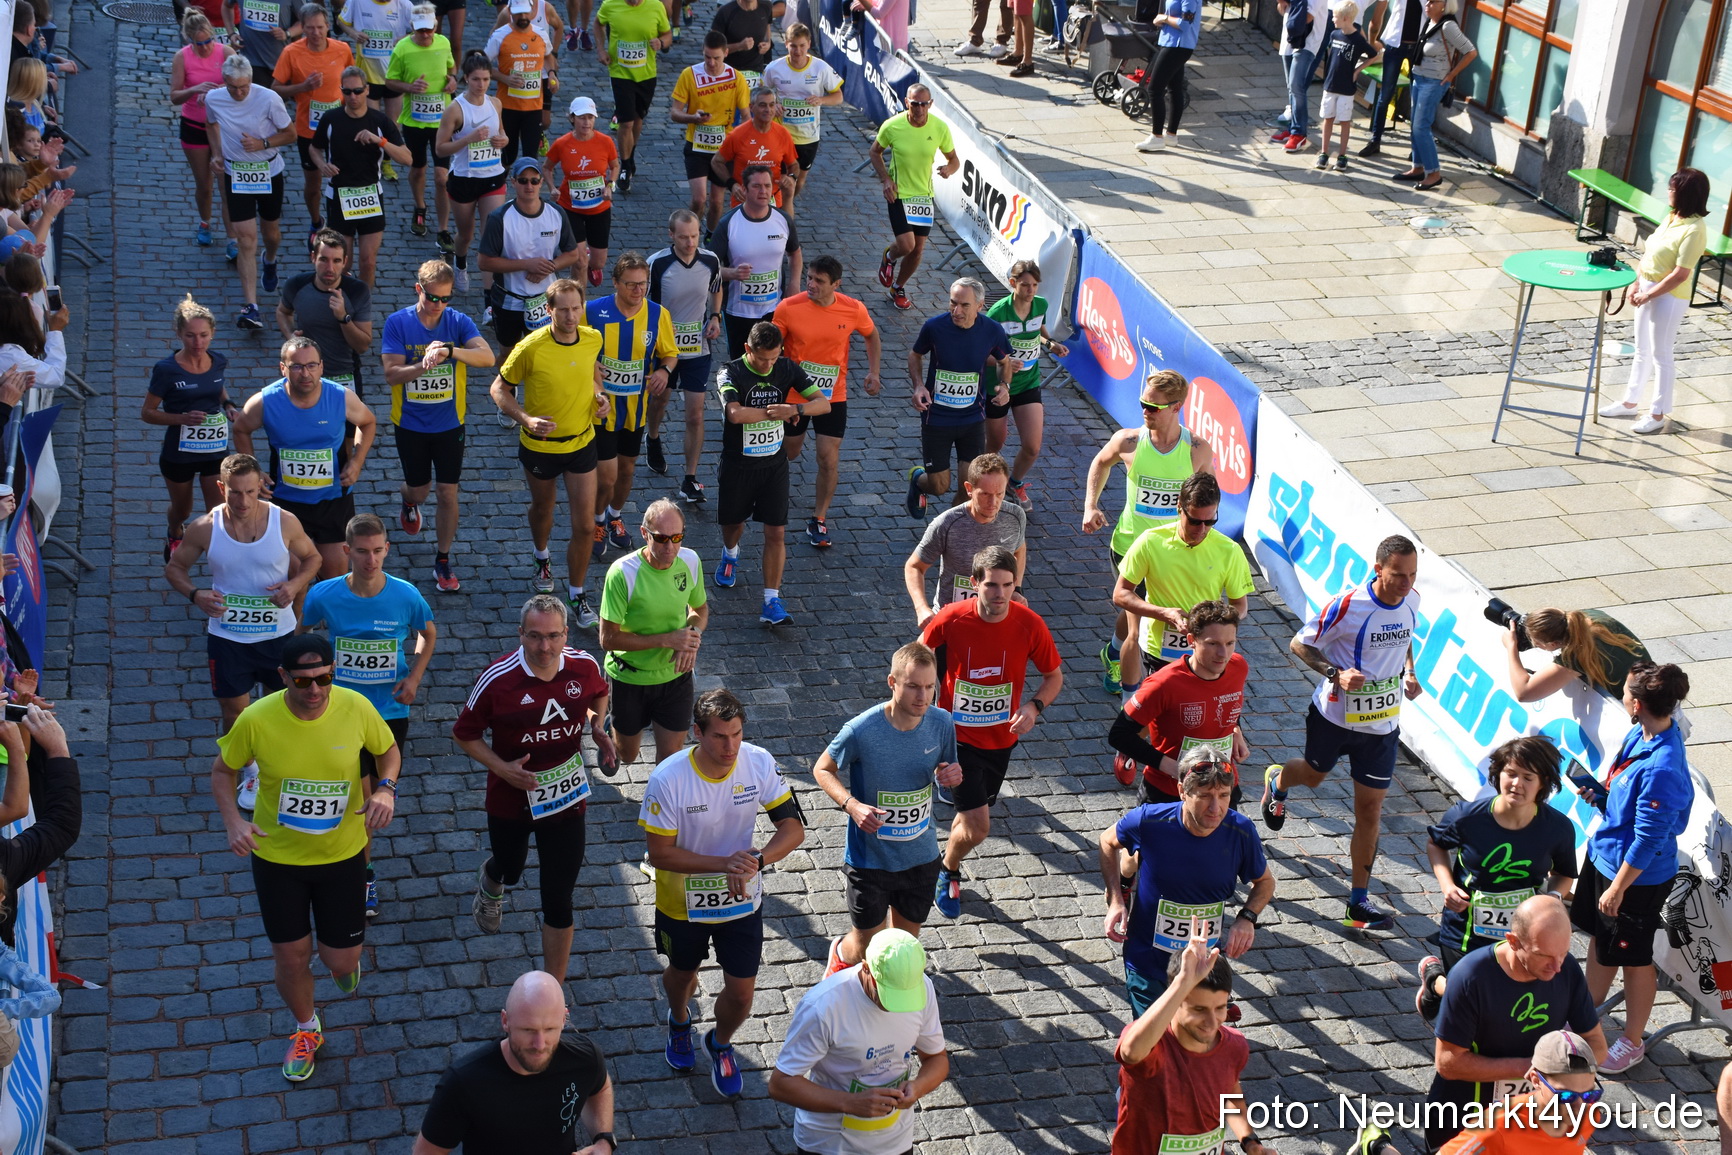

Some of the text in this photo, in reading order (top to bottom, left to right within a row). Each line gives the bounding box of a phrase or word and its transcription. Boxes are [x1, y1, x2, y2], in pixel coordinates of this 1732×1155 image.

[245, 1, 276, 10] BOCK
[247, 11, 275, 22] 2128
[365, 39, 390, 49] 2337
[621, 49, 643, 58] 1226
[697, 82, 737, 98] MAX BÖGL
[413, 93, 444, 102] BOCK
[415, 102, 442, 112] 2248
[786, 108, 813, 118] 2304
[698, 133, 723, 144] 1239
[473, 148, 497, 160] 2774
[237, 172, 266, 183] 3002
[571, 178, 602, 188] BOCK
[575, 187, 602, 200] 2763
[961, 159, 1007, 231] swn
[345, 195, 376, 209] 1088
[349, 207, 376, 216] CARSTEN
[907, 205, 931, 217] 2800
[745, 281, 775, 294] 2222
[1080, 283, 1133, 366] Hervis
[605, 357, 641, 371] BOCK
[804, 360, 837, 374] BOCK
[603, 369, 637, 384] 2701
[942, 371, 975, 382] BOCK
[412, 378, 448, 391] 1349
[940, 382, 973, 397] 2440
[415, 392, 445, 400] JÜRGEN
[751, 391, 778, 399] LAUFEN
[938, 394, 972, 403] WOLFGANG
[186, 425, 224, 441] 2626
[749, 430, 780, 445] 2051
[184, 440, 224, 451] ROSWITHA
[751, 442, 783, 454] RÜDIGER
[284, 450, 328, 460] BOCK
[287, 463, 328, 477] 1374
[1141, 478, 1181, 490] BOCK
[1141, 491, 1178, 506] 2793
[227, 595, 272, 608] BOCK
[227, 610, 274, 624] 2256
[226, 624, 272, 633] JOHANNES
[1380, 623, 1403, 632] TEAM
[1370, 629, 1411, 643] ERDINGER
[341, 640, 391, 651] BOCK
[342, 654, 390, 668] 2482
[341, 669, 390, 679] ALEXANDER
[959, 684, 1008, 698] BOCK
[960, 697, 1005, 713] 2560
[1352, 693, 1395, 711] 1130
[961, 714, 1000, 723] DOMINIK
[1184, 715, 1202, 723] NEU
[1359, 711, 1389, 722] DANIEL
[520, 721, 583, 744] AREVA
[534, 761, 583, 784] BOCK
[291, 781, 342, 796] BOCK
[535, 771, 582, 803] 2786
[542, 786, 584, 813] MAREK
[733, 791, 760, 801] Neumarkter
[734, 797, 755, 806] Stadtlauf
[884, 789, 931, 806] BOCK
[286, 797, 340, 816] 2831
[884, 802, 928, 825] 2597
[892, 825, 923, 837] DANIEL
[691, 878, 727, 890] BOC
[702, 908, 732, 917] Markus
[1164, 904, 1218, 917] BOCK
[1163, 919, 1215, 937] 253
[1169, 1132, 1222, 1150] BOCK
